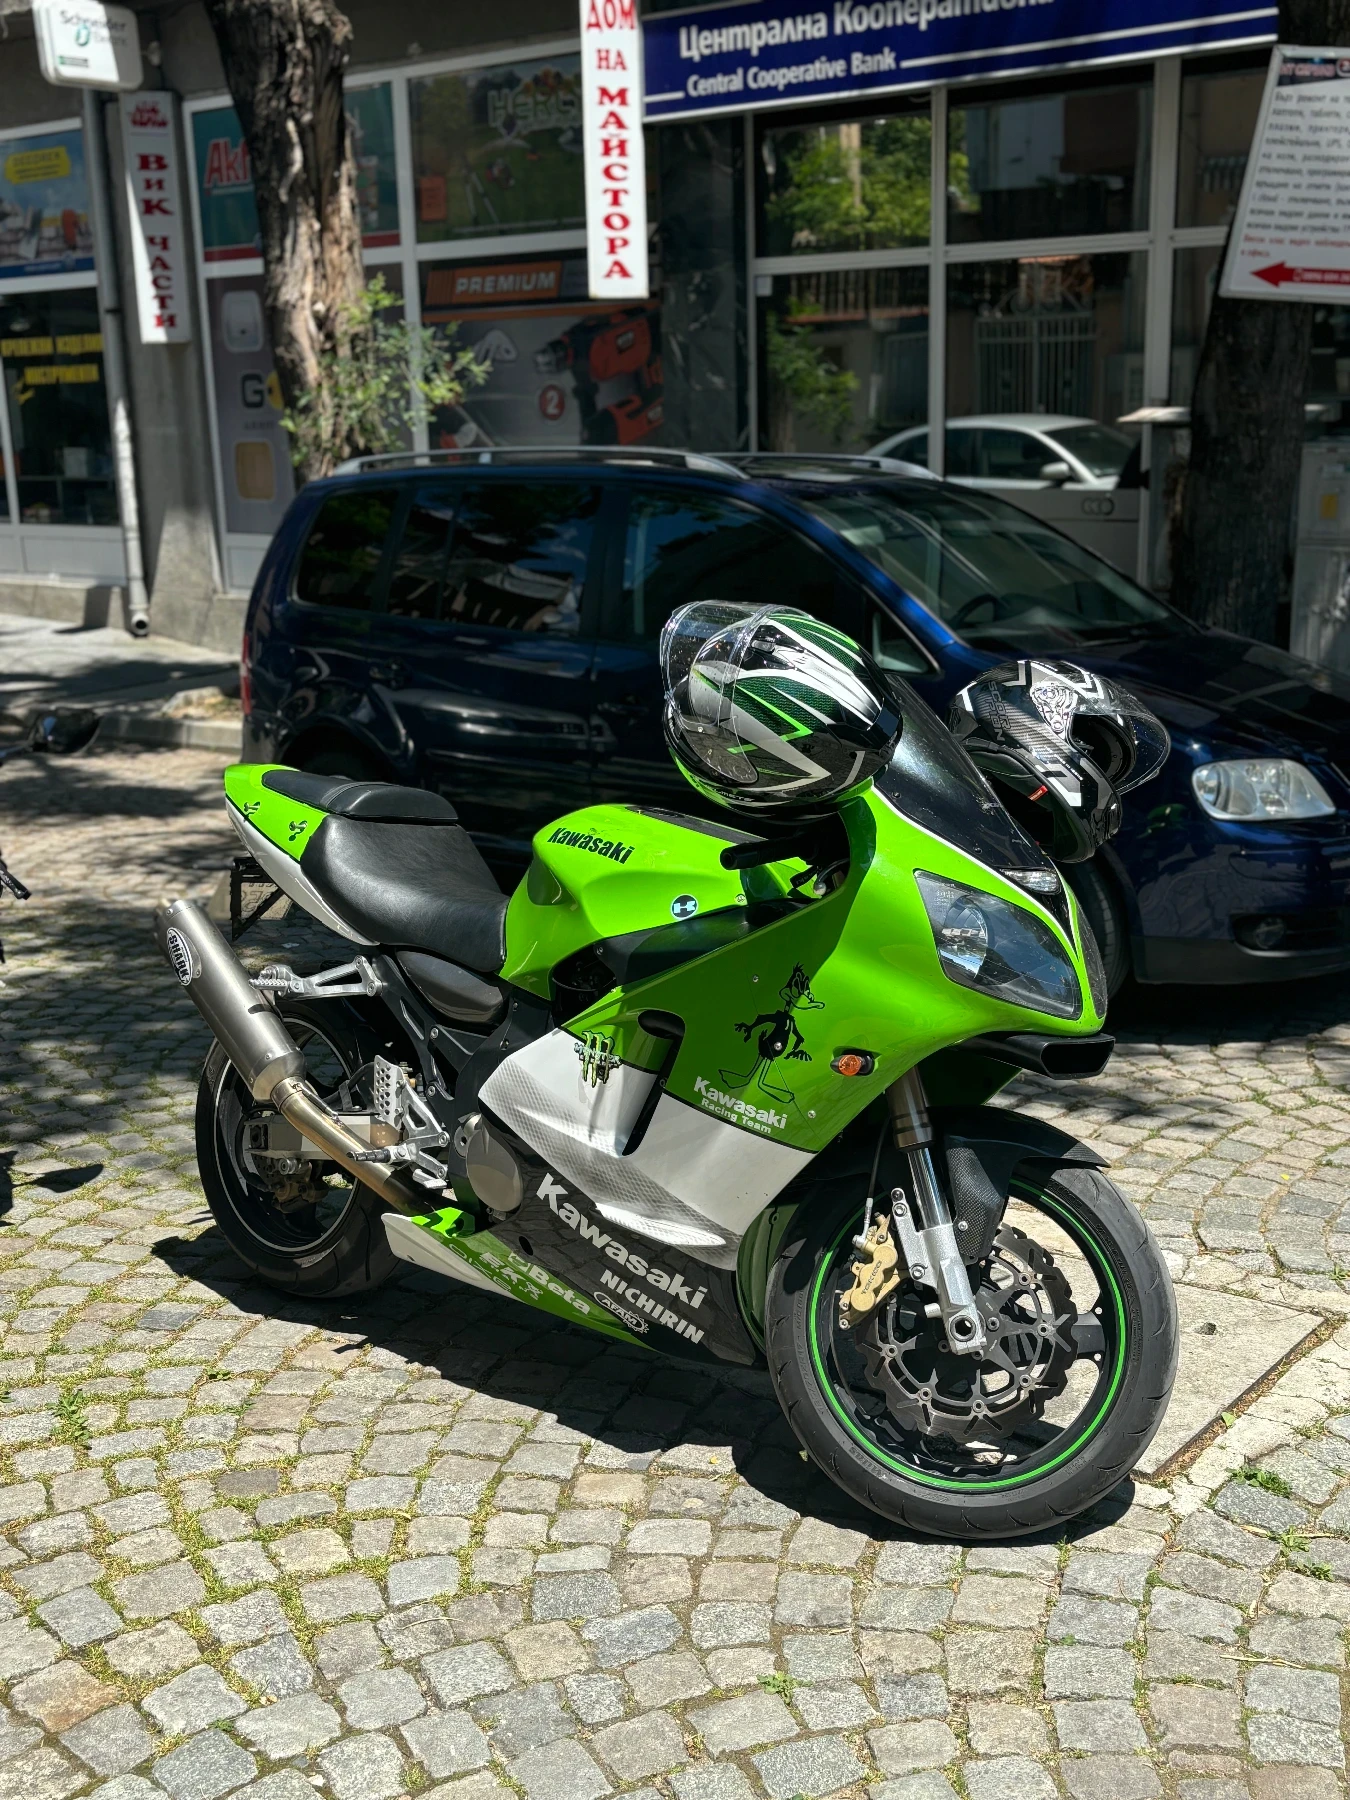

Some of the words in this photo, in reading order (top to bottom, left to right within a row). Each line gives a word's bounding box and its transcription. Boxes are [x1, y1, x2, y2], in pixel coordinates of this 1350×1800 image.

[596, 49, 627, 70] НА
[679, 12, 827, 61] Централна
[687, 68, 743, 97] Central
[747, 56, 846, 90] Cooperative
[851, 47, 897, 73] Bank
[596, 87, 633, 279] МАЙСТОРА
[147, 235, 178, 328] ЧАСТИ
[455, 270, 557, 294] PREMIUM
[545, 389, 559, 414] 2
[547, 827, 636, 865] Kawasaki
[168, 934, 190, 978] SHARK
[693, 1076, 788, 1130] Kawasaki
[701, 1098, 738, 1123] Racing
[741, 1115, 772, 1134] Team
[536, 1173, 708, 1309] Kawasaki
[528, 1265, 591, 1315] Beta
[600, 1269, 705, 1344] NICHIRIN
[601, 1298, 638, 1326] AFAM
